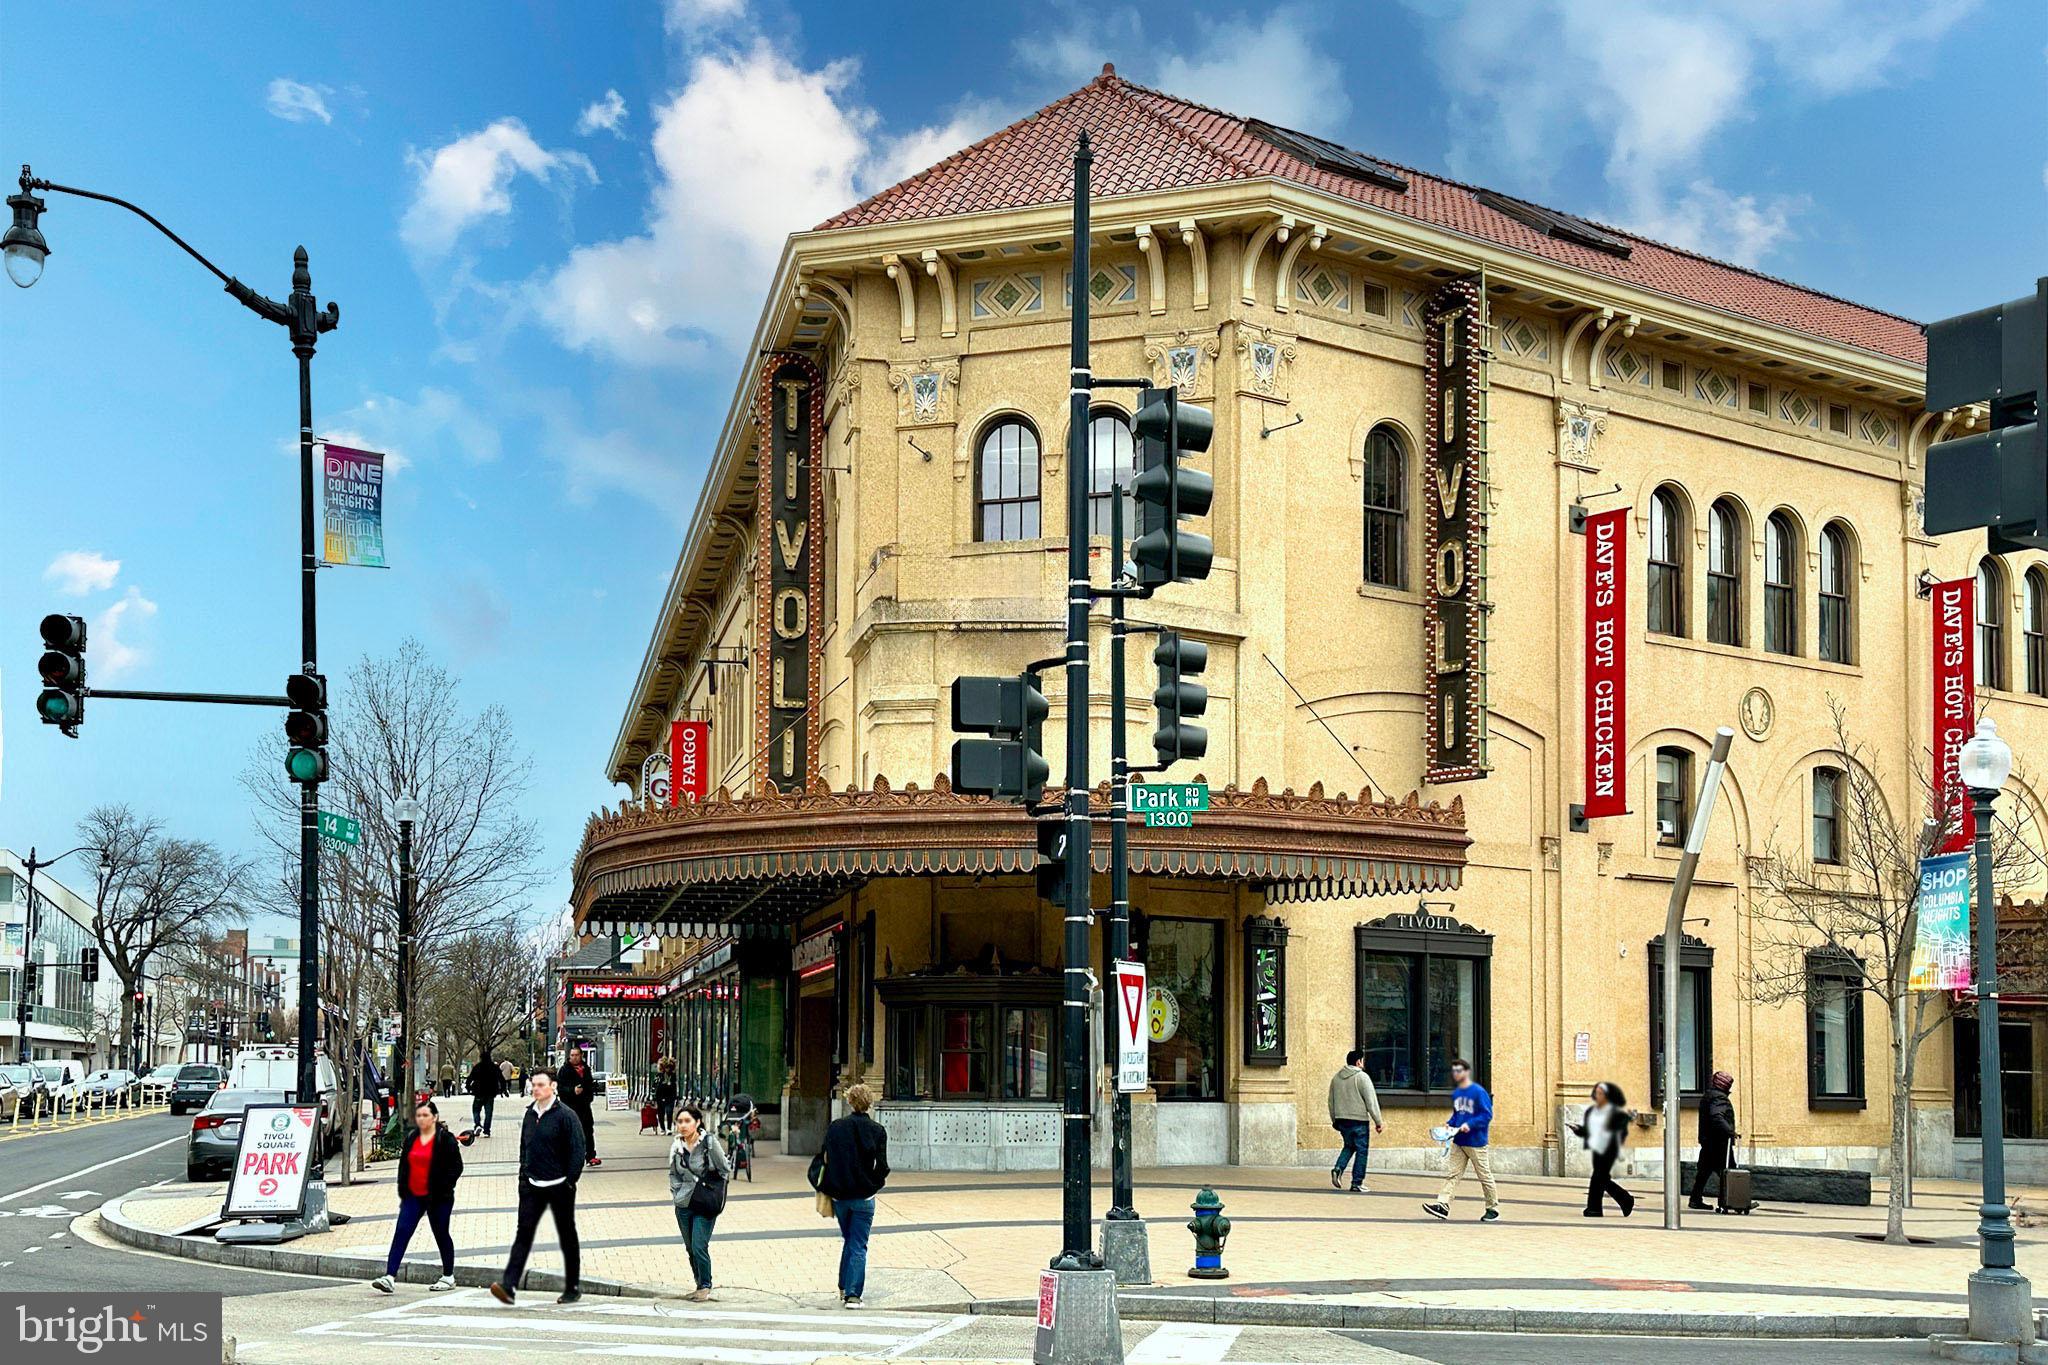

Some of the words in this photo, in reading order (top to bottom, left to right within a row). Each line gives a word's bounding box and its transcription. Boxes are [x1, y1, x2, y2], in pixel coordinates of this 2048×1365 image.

[326, 457, 381, 484] DINE
[328, 478, 378, 498] COLUMBIA
[331, 492, 375, 511] HEIGHTS
[1435, 308, 1465, 750] TIVOLI
[1595, 521, 1615, 608] DAVE'S
[773, 379, 809, 778] TIVOLI
[1942, 587, 1963, 667] DAVE'S
[1595, 617, 1615, 667] HOT
[1944, 674, 1964, 720] HOT
[1594, 680, 1615, 798] CHICKEN
[682, 728, 697, 785] FARGO
[1136, 787, 1179, 807] Park
[1185, 787, 1199, 797] RD
[1185, 797, 1199, 807] NW
[323, 815, 337, 834] 14
[1150, 811, 1188, 826] 1300
[323, 836, 347, 852] 3300
[1921, 867, 1968, 891] SHOP
[1922, 890, 1965, 909] COLUMBIA
[1397, 914, 1450, 930] TIVOLI
[1922, 905, 1961, 925] HEIGHTS
[257, 1141, 297, 1150] SQUARE
[263, 1133, 294, 1141] TIVOLI
[243, 1151, 302, 1175] PARK
